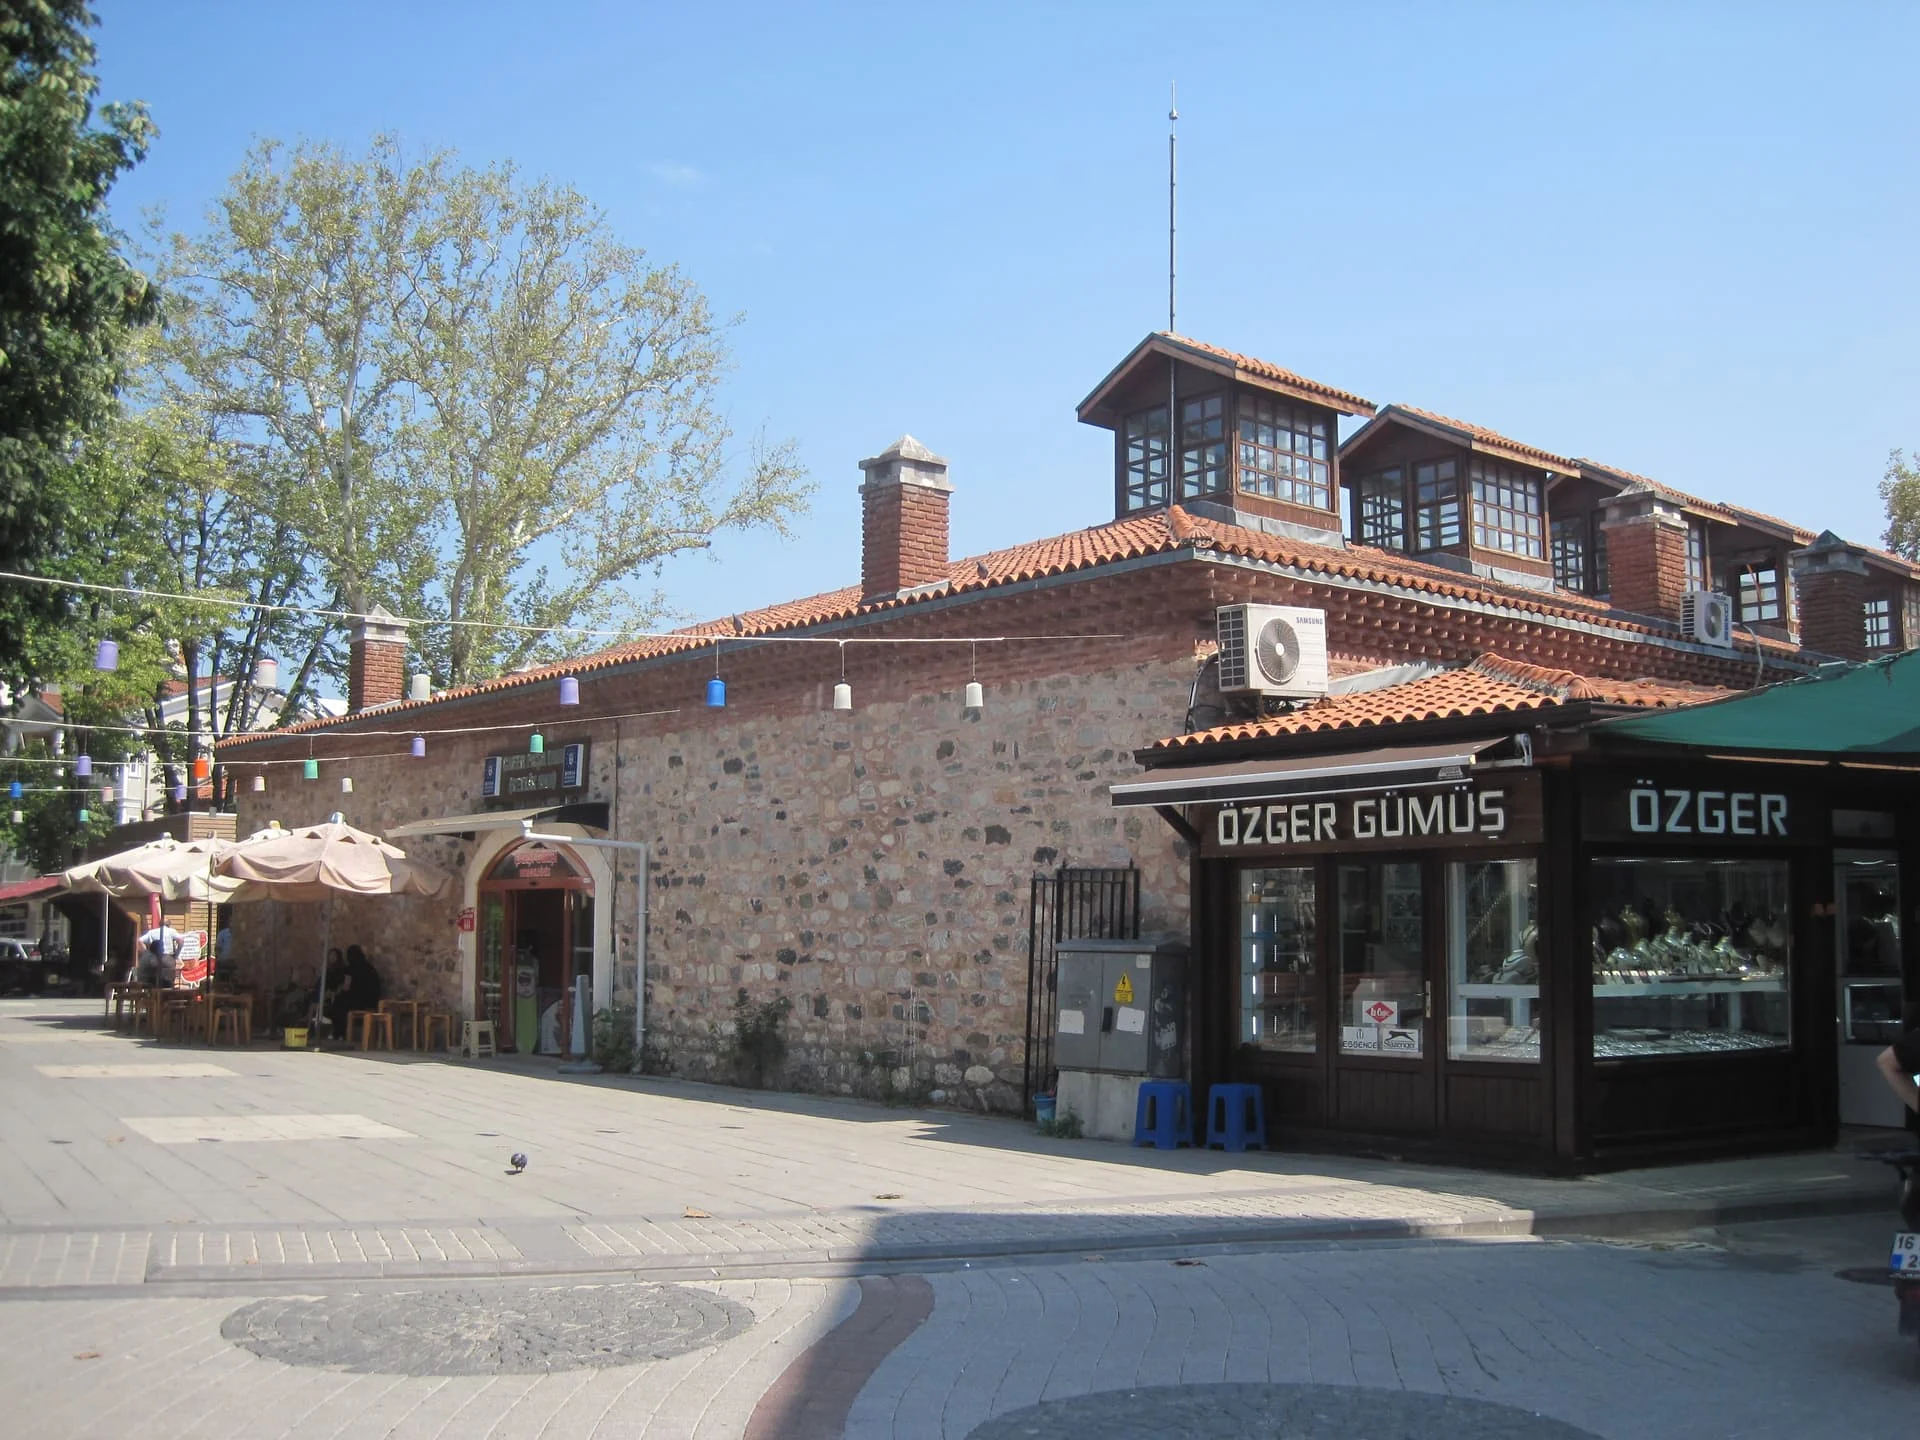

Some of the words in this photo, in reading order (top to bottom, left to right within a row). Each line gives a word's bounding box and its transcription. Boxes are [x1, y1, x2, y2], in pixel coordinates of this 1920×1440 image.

[1295, 616, 1324, 626] SAMSUNG
[1218, 801, 1337, 846] ÖZGER
[1353, 785, 1504, 840] GÜMÜŞ
[1629, 779, 1788, 836] ÖZGER
[1898, 1235, 1914, 1250] 16
